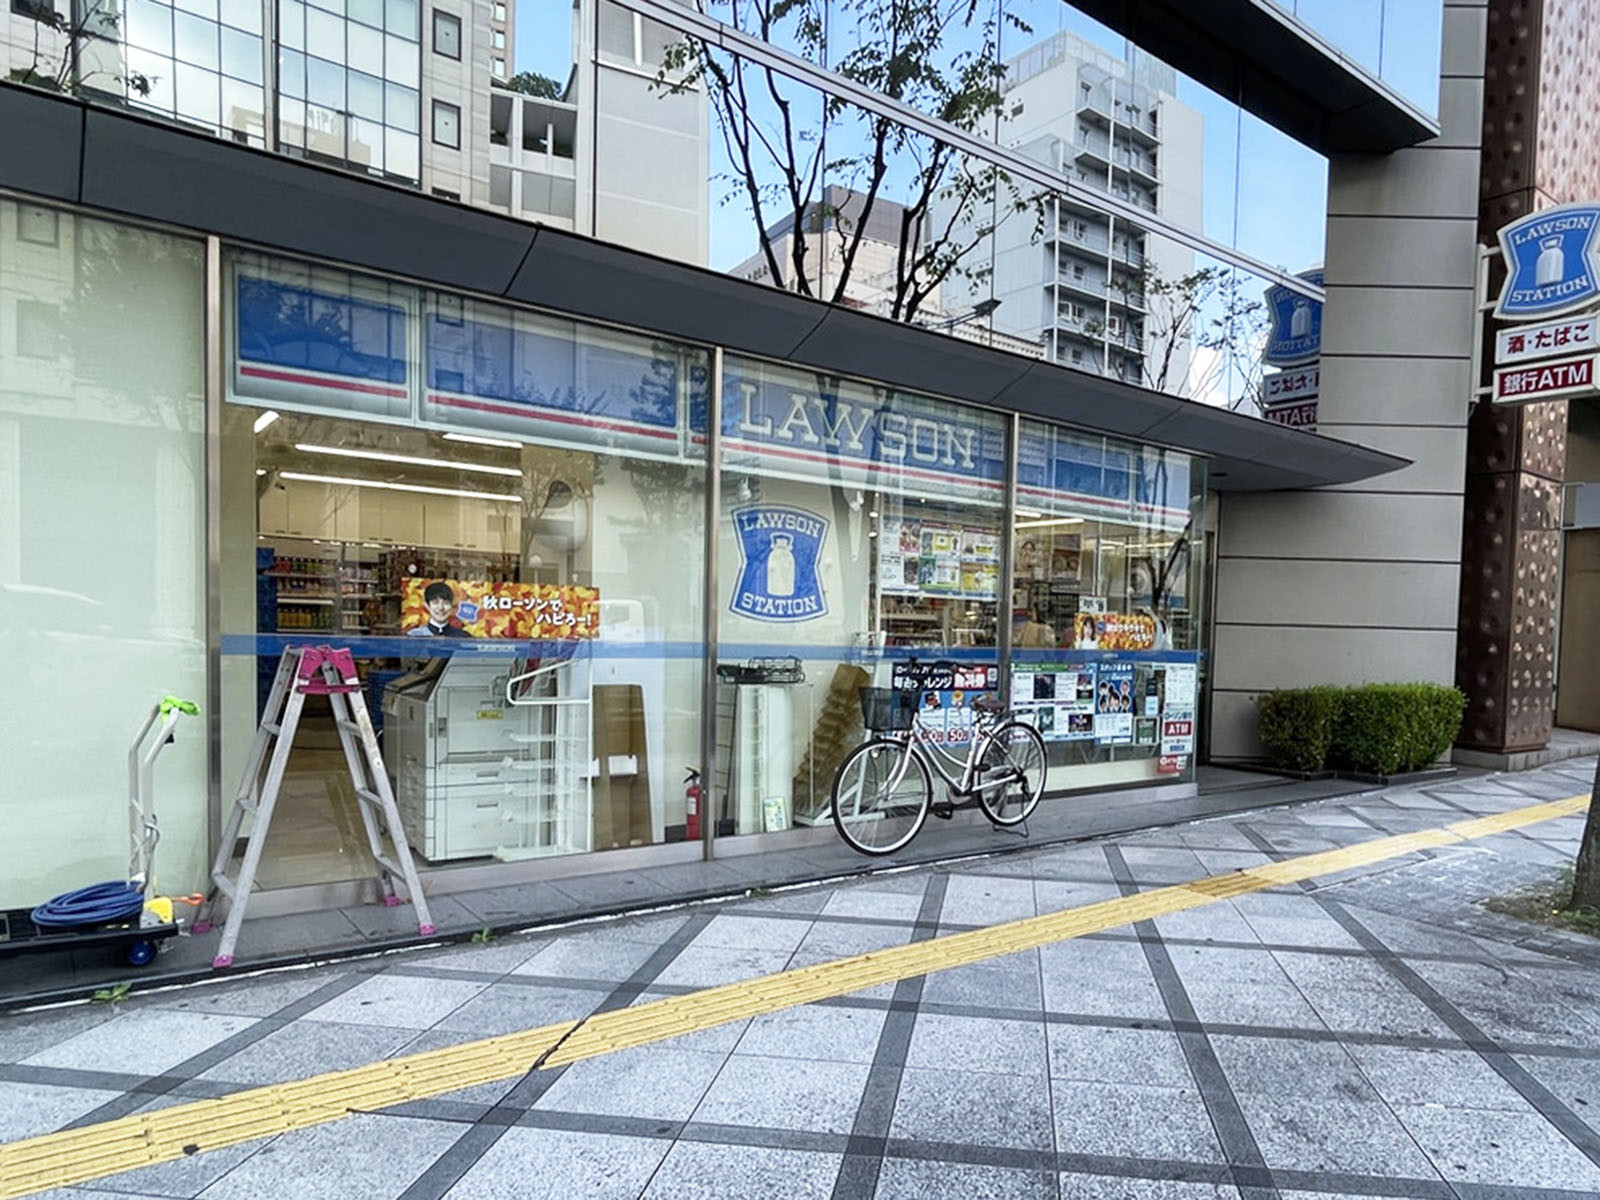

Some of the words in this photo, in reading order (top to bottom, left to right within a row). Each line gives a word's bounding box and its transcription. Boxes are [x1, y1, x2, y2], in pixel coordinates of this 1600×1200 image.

[1513, 216, 1592, 246] LAWSON
[1511, 275, 1589, 302] STATION
[1507, 324, 1590, 354] 酒・たばこ
[1503, 362, 1588, 394] 銀行ATM
[739, 382, 976, 470] LAWSON
[741, 514, 821, 538] LAWSON
[483, 595, 563, 611] 秋ローソンで
[741, 591, 818, 615] STATION
